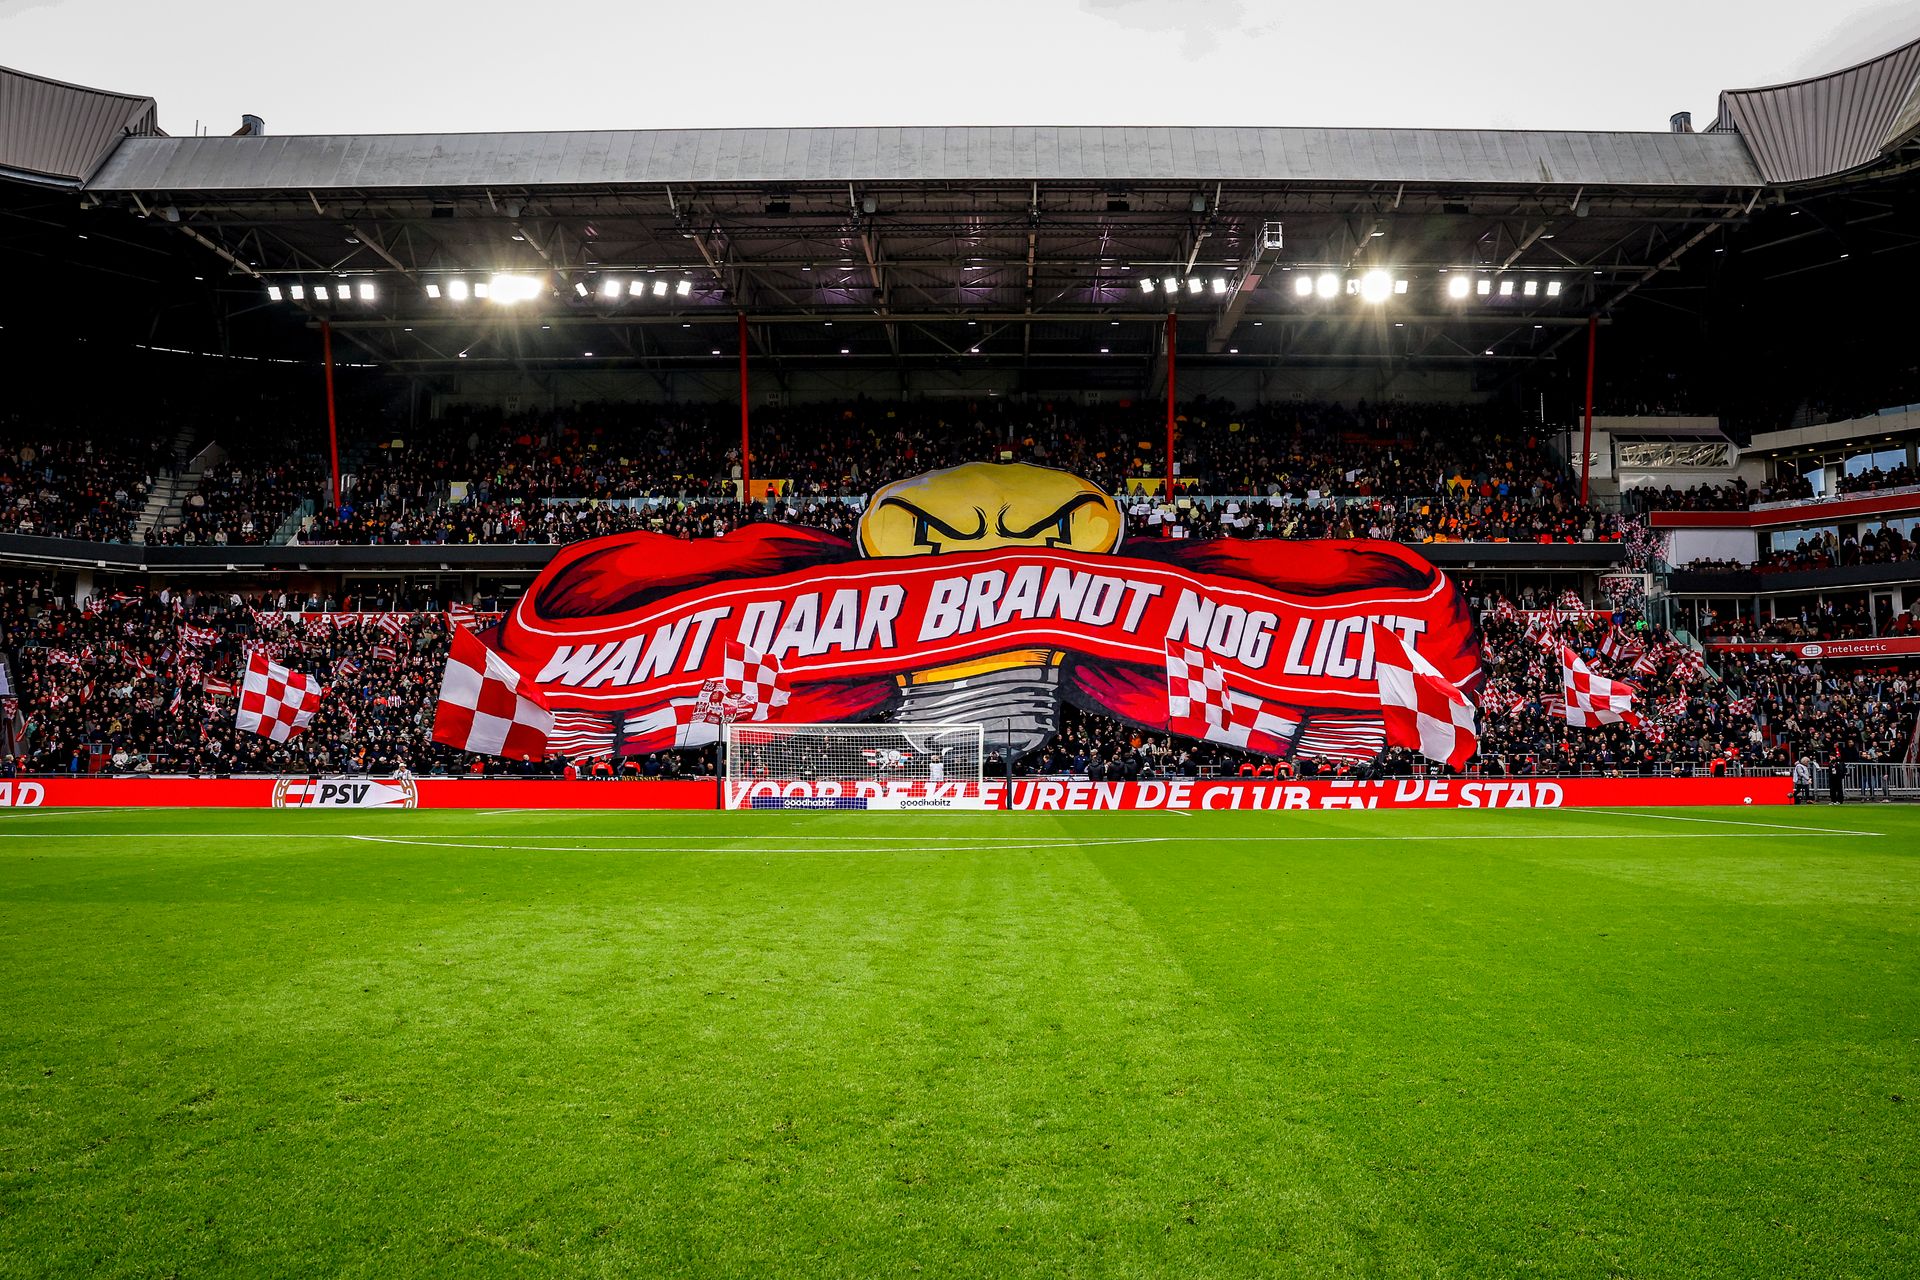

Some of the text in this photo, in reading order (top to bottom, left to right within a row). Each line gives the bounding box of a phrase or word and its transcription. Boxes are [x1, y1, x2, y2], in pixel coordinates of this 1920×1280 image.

[535, 606, 732, 688] WANT
[737, 584, 906, 660] DAAR
[917, 565, 1163, 642] BRANDT
[1166, 588, 1278, 669] NOG
[1827, 643, 1887, 654] Intelectric
[319, 784, 370, 804] PSV
[1135, 781, 1195, 809] DE
[1201, 786, 1311, 810] CLUB
[1394, 780, 1450, 802] DE
[1458, 782, 1564, 808] STAD
[784, 798, 835, 809] goodhabitz
[900, 798, 951, 809] goodhabitz
